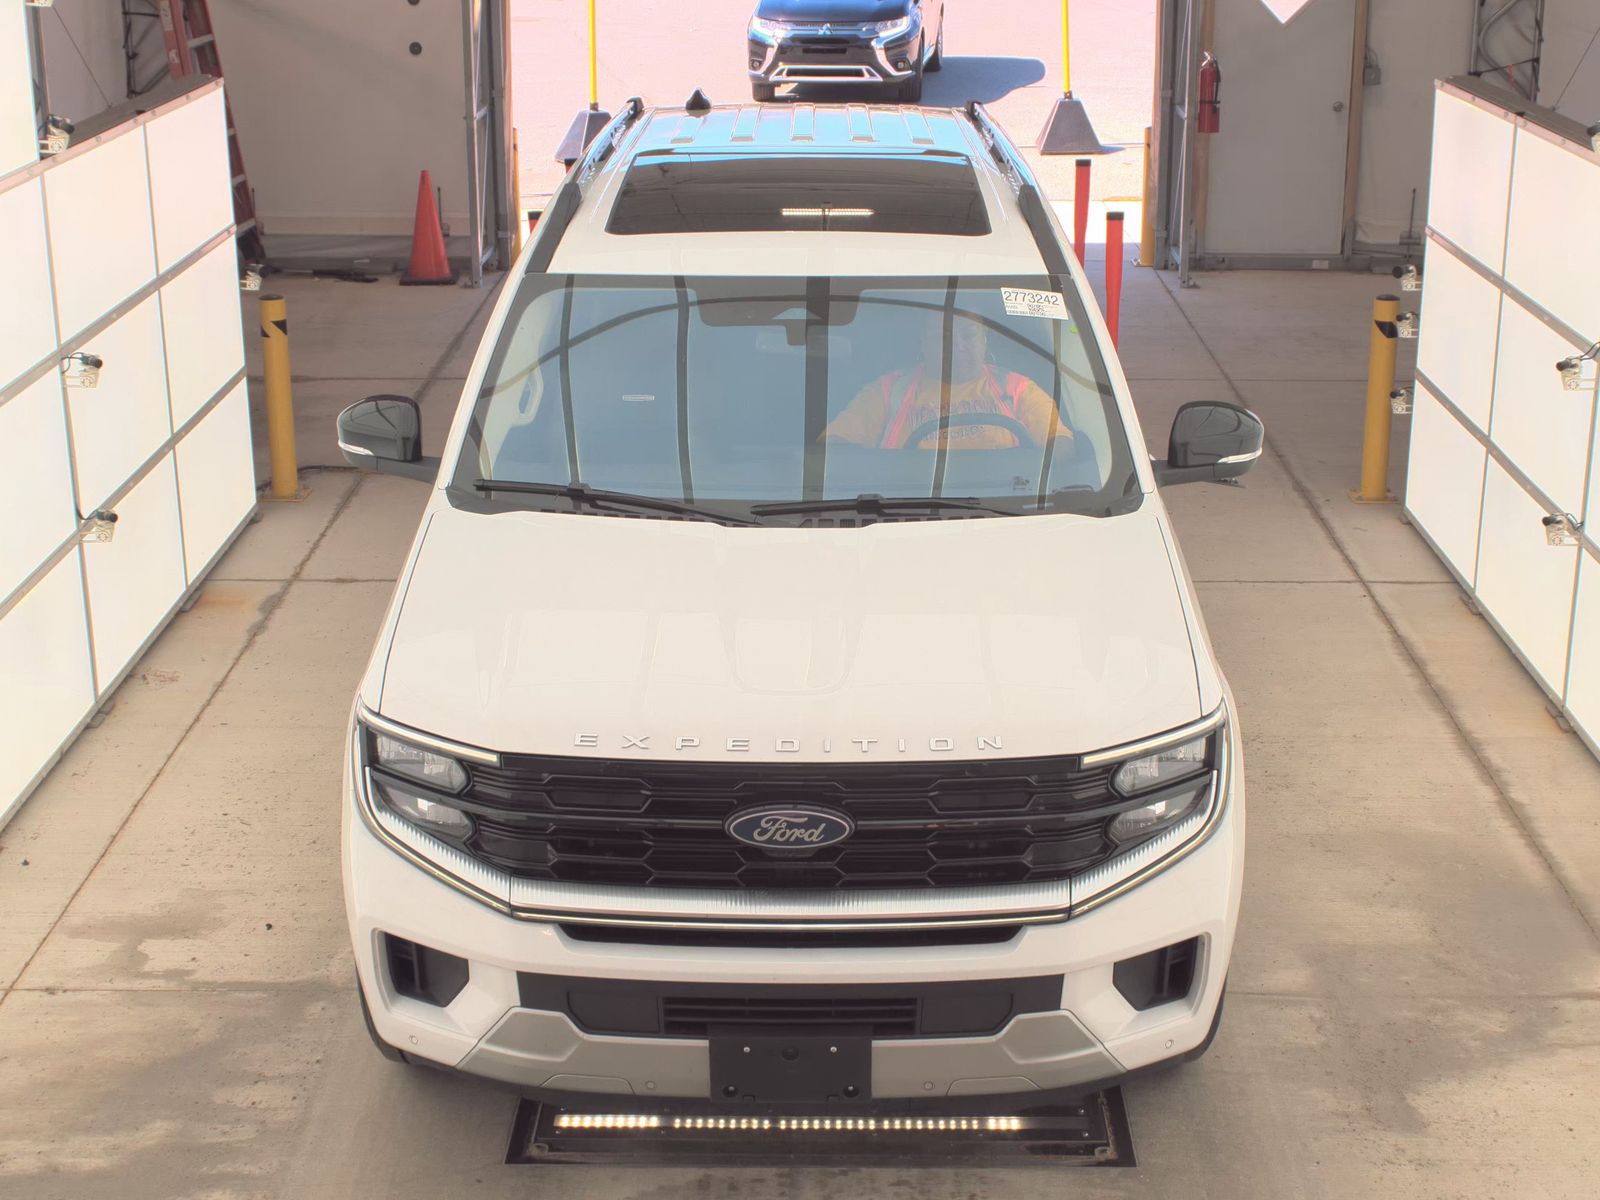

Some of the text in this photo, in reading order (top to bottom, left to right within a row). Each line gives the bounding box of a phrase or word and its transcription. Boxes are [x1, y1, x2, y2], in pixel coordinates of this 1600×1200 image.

[1003, 290, 1060, 306] 2773242
[574, 733, 1003, 752] EXPEDITION
[753, 815, 826, 842] Ford
